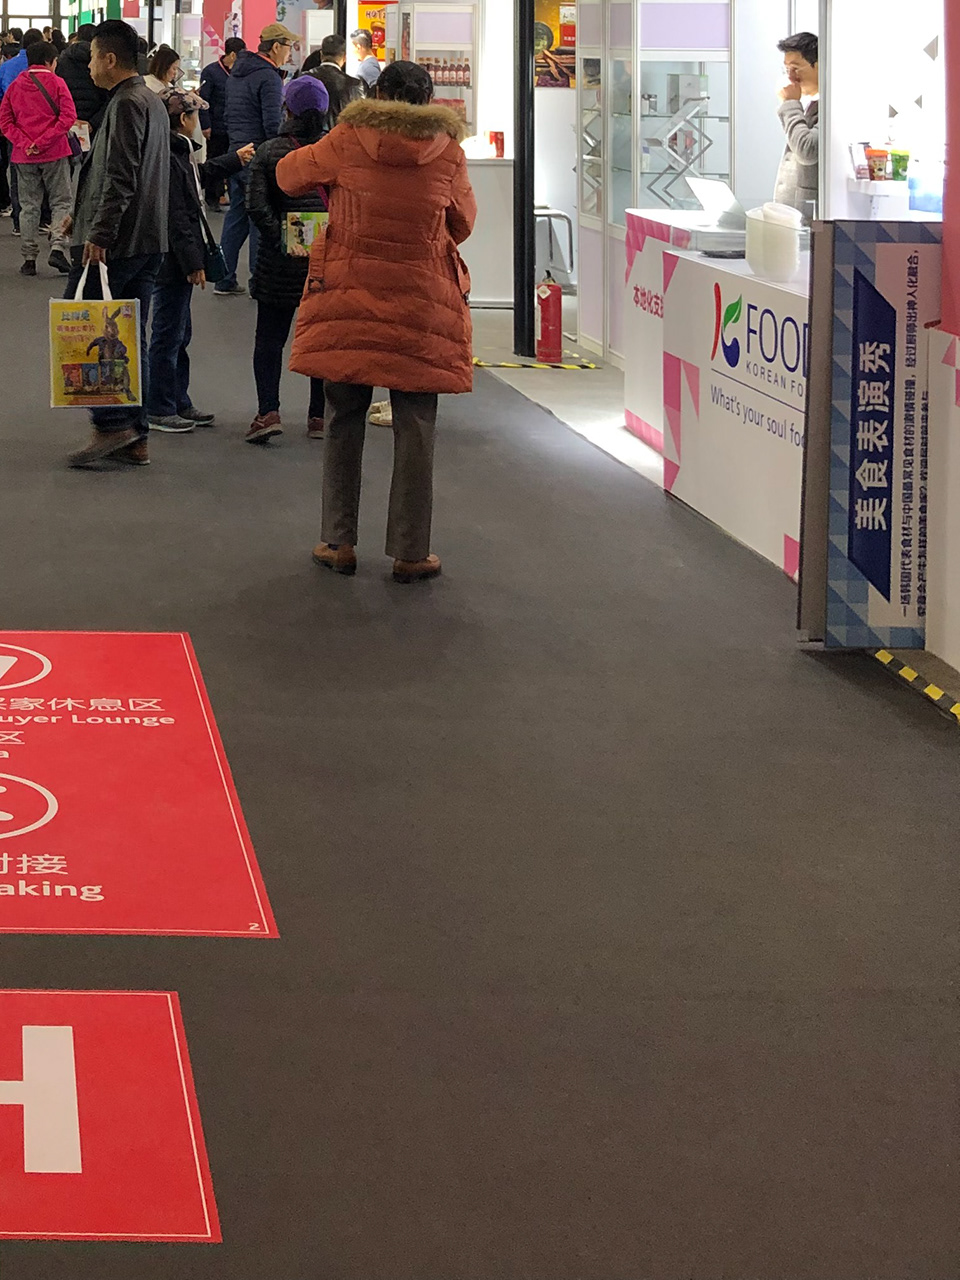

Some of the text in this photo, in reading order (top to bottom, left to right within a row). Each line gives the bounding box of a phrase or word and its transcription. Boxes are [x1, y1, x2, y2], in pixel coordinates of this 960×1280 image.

[746, 360, 787, 391] KOREAN
[710, 383, 741, 416] What's
[742, 402, 765, 428] your
[767, 416, 787, 441] soul
[855, 341, 892, 530] 美食表演秀
[72, 715, 175, 727] Lounge
[248, 921, 260, 931] 2
